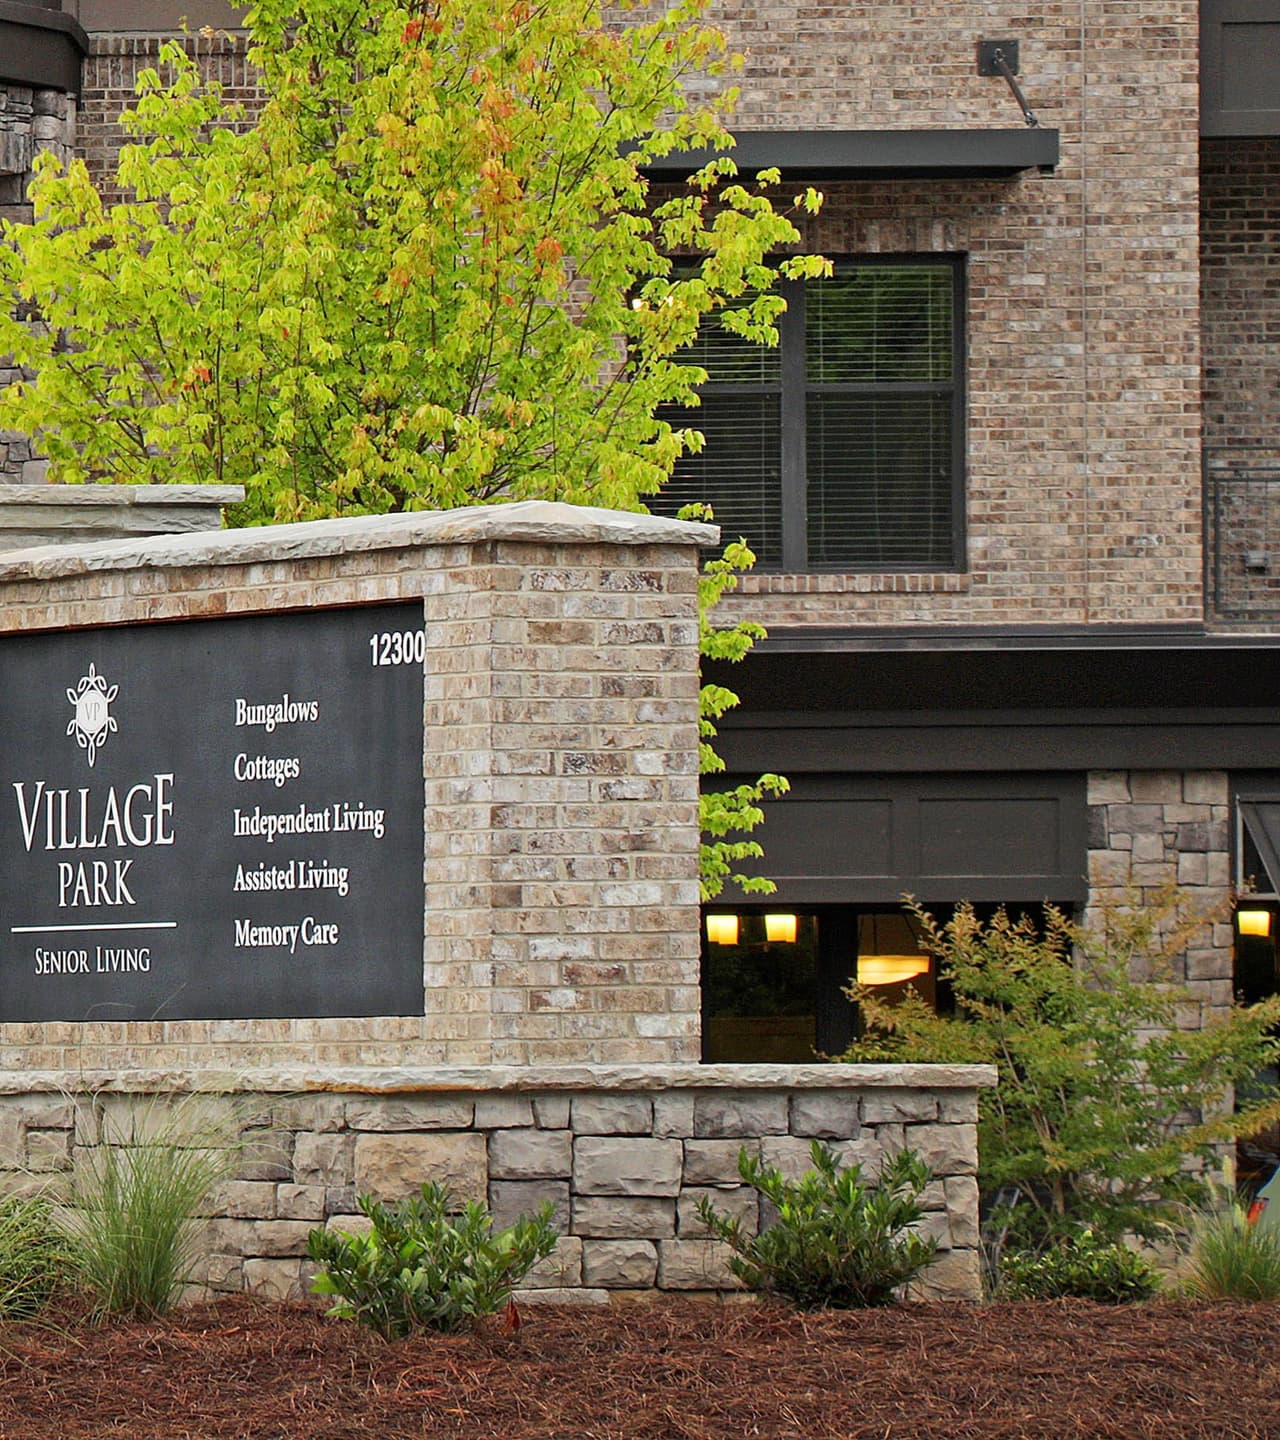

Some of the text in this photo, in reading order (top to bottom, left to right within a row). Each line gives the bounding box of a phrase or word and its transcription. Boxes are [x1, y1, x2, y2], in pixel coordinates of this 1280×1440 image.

[369, 630, 425, 666] 12300
[234, 693, 319, 733] Bungalows
[233, 752, 300, 788] Cottages
[12, 773, 175, 852] VILLAGE
[233, 801, 385, 843] Independent Living
[58, 859, 137, 908] PARK
[233, 859, 349, 897] Assisted Living
[234, 916, 339, 955] Memory Care
[34, 945, 151, 975] SENIOR LIVING
